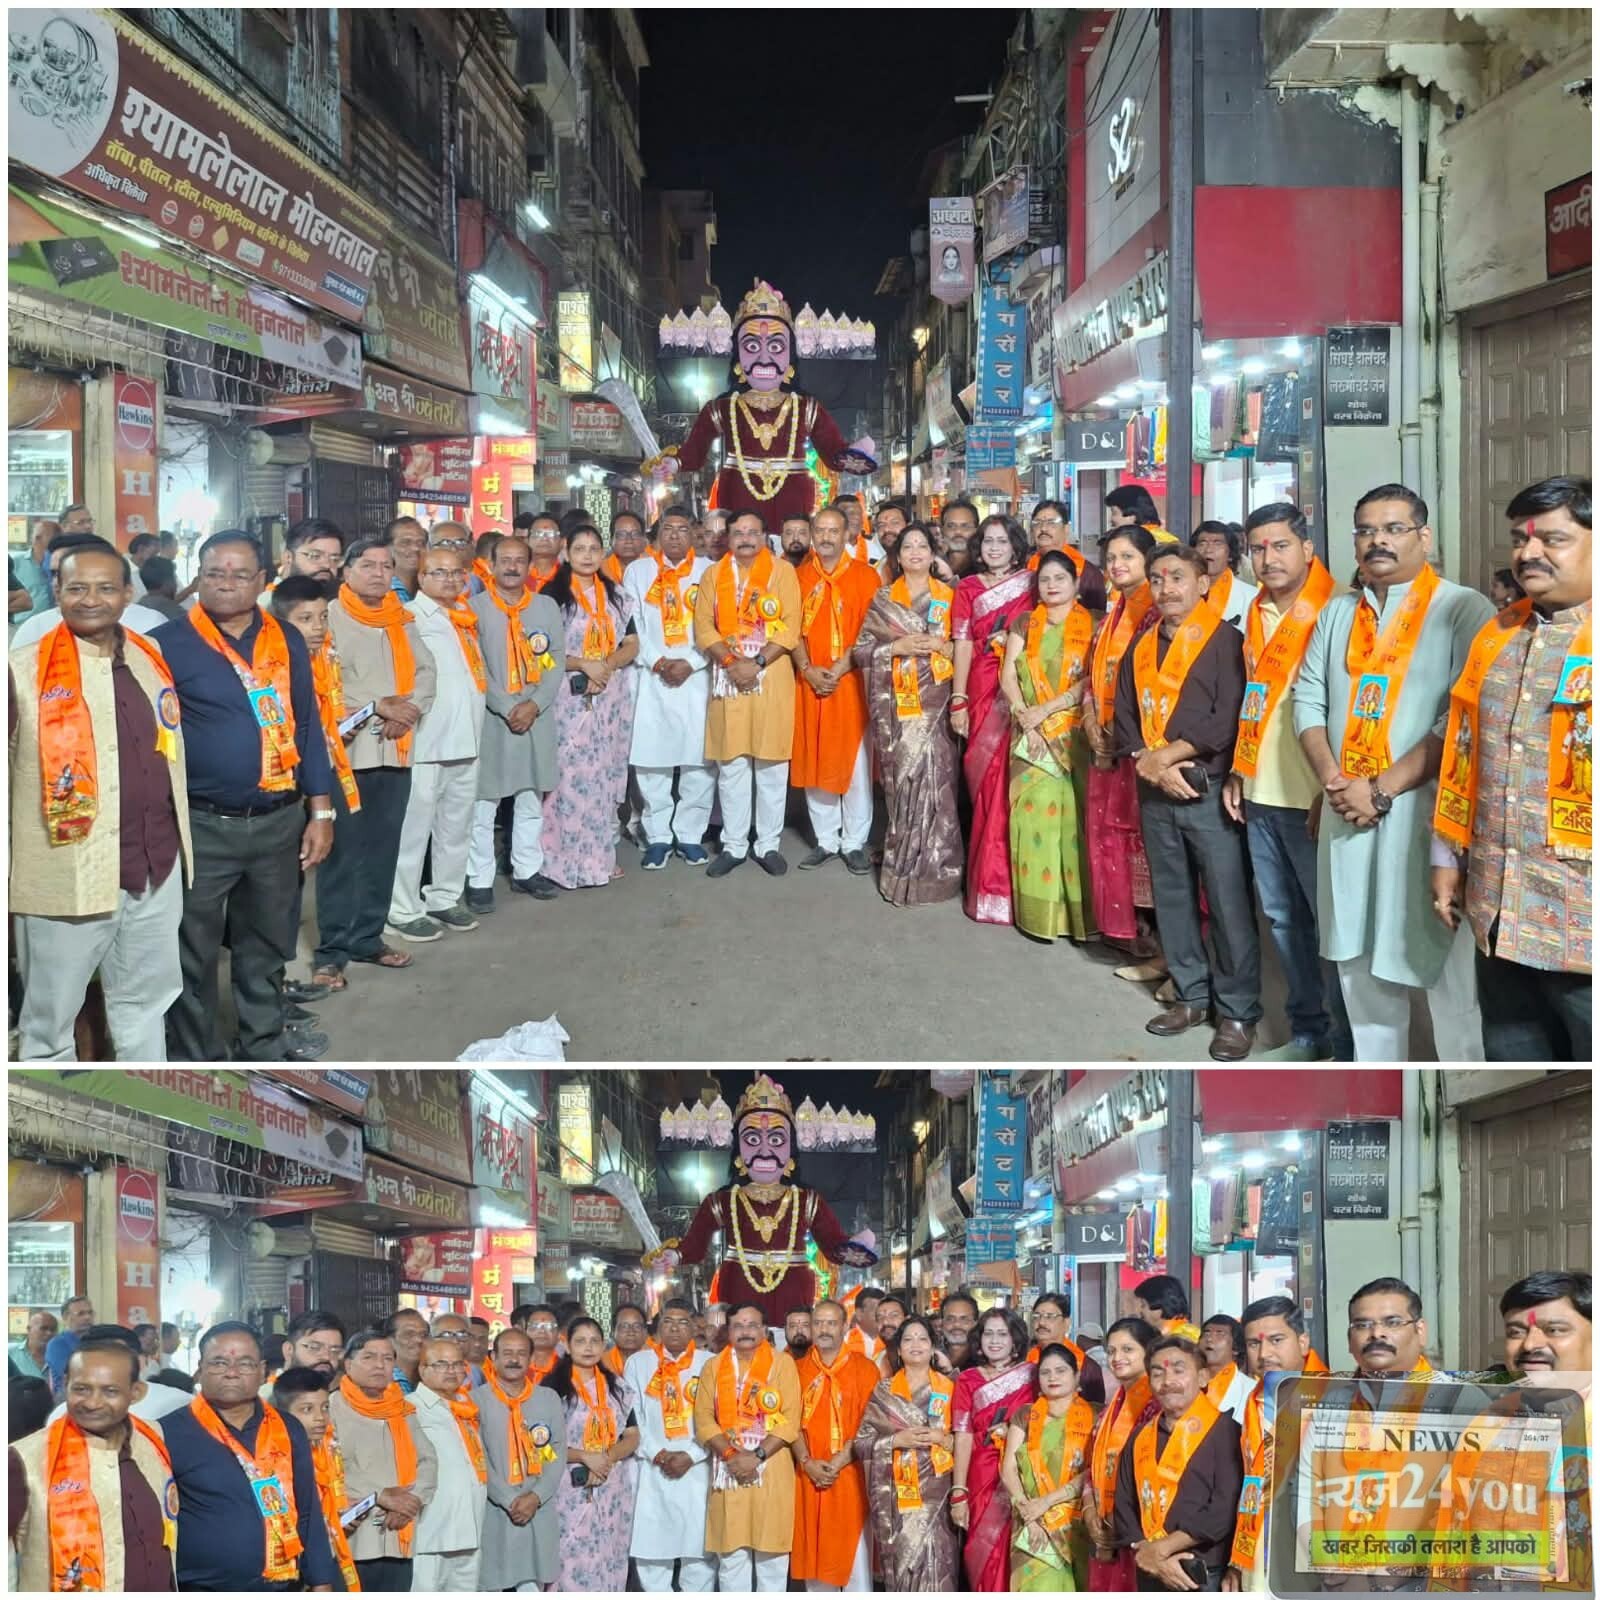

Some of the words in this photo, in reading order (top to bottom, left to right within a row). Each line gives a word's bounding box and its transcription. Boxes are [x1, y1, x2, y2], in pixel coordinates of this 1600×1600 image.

[120, 86, 288, 222] श्यामलेलाल
[288, 191, 379, 277] मोहनलाल
[119, 406, 154, 426] Hawkins
[1081, 431, 1125, 450] D&J
[120, 1197, 155, 1219] Hawkins
[1081, 1224, 1125, 1243] D&J
